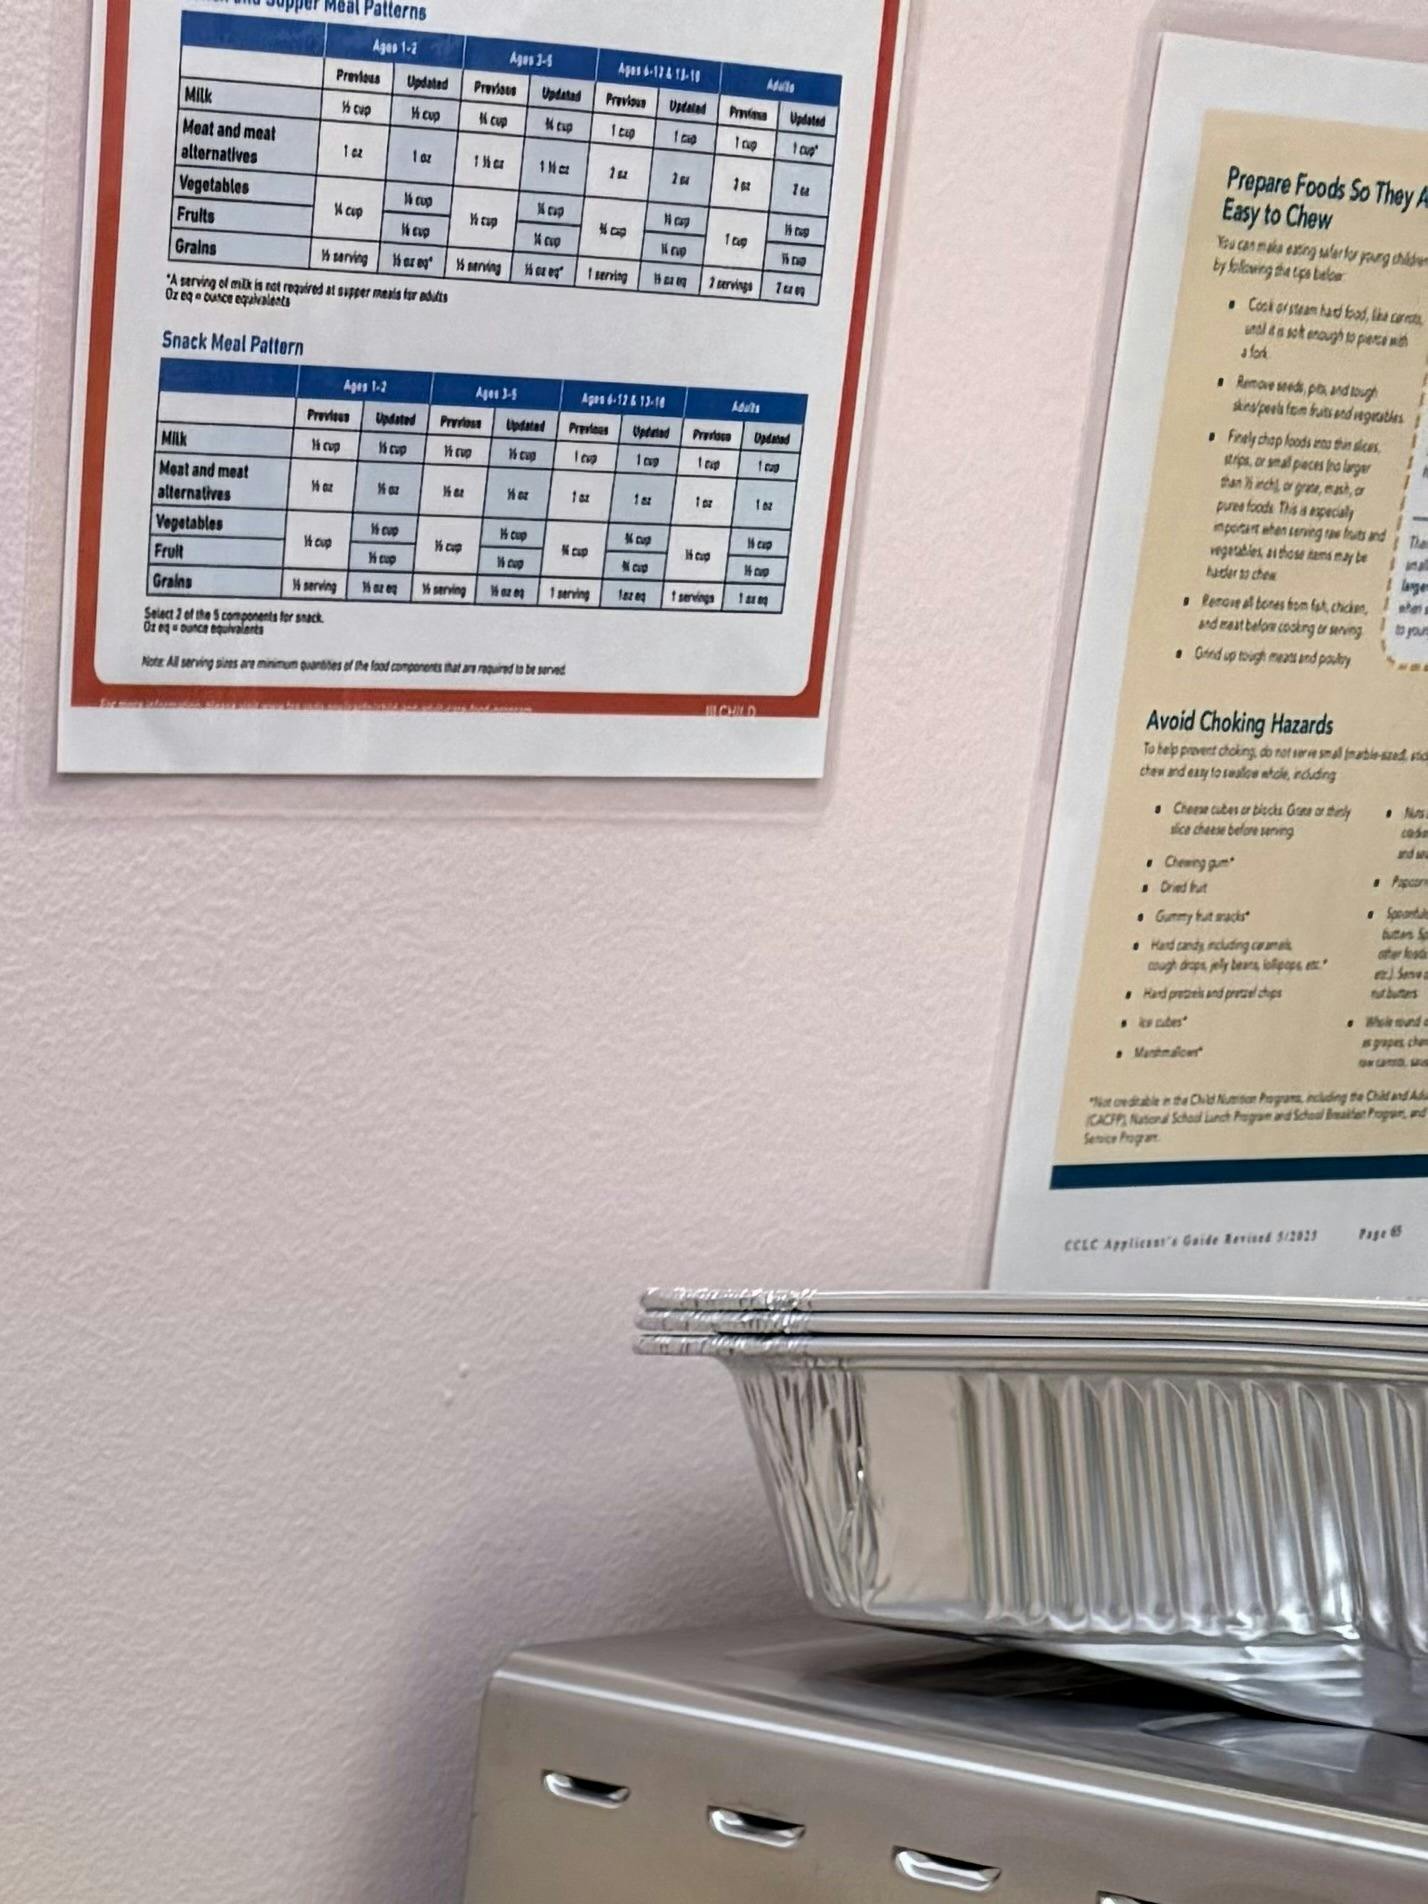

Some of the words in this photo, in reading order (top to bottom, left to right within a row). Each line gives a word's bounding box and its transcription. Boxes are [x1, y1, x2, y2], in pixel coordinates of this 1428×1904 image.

[337, 69, 380, 84] Previous
[185, 87, 212, 103] Milk
[183, 119, 214, 137] Meat
[216, 122, 240, 138] and
[243, 125, 276, 141] meat
[181, 146, 257, 164] alternatives
[180, 175, 249, 195] Vegetables
[1227, 165, 1290, 197] Prepare
[1295, 173, 1344, 200] Foods
[1349, 178, 1370, 201] So
[1375, 181, 1413, 212] They
[177, 206, 215, 224] Fruits
[1223, 197, 1260, 229] Easy
[1265, 205, 1280, 225] to
[1285, 204, 1333, 231] Chew
[175, 238, 217, 256] Grains
[162, 331, 207, 350] Snack
[211, 333, 245, 352] Meal
[250, 336, 304, 355] Pattern
[1146, 709, 1194, 732] Avoid
[1199, 711, 1265, 737] Choking
[1270, 714, 1334, 735] Hazards
